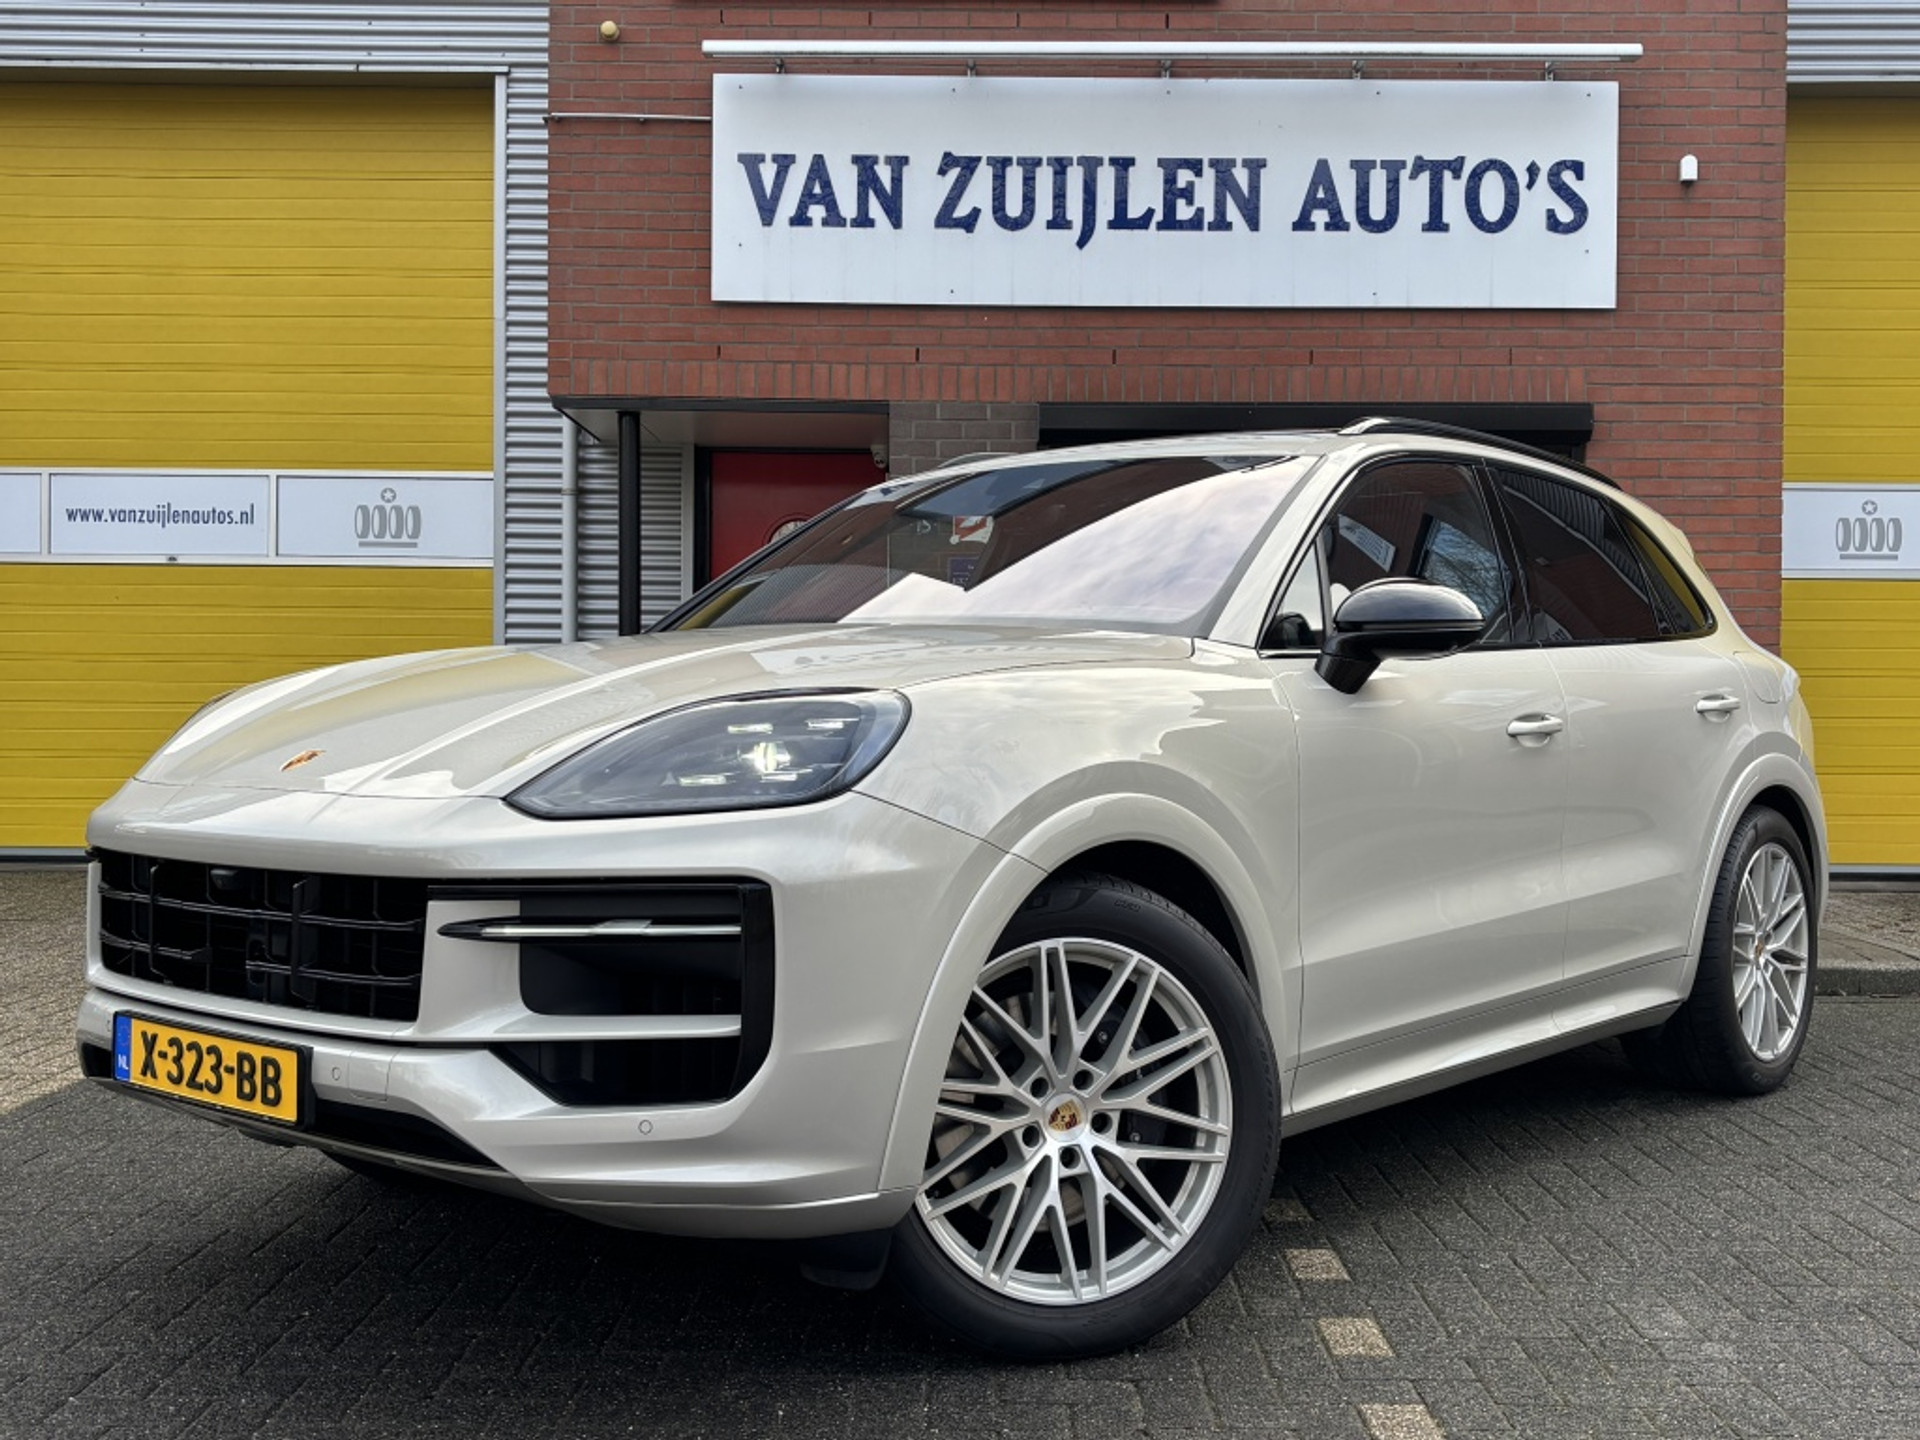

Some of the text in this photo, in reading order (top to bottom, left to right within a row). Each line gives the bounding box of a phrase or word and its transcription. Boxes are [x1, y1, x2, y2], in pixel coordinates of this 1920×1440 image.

[737, 151, 1589, 251] VAN ZUIJLEN AUTO'S
[65, 502, 255, 529] www.vanzuijlenautos.nl
[118, 1053, 129, 1070] NL
[140, 1030, 283, 1108] X-323-BB
